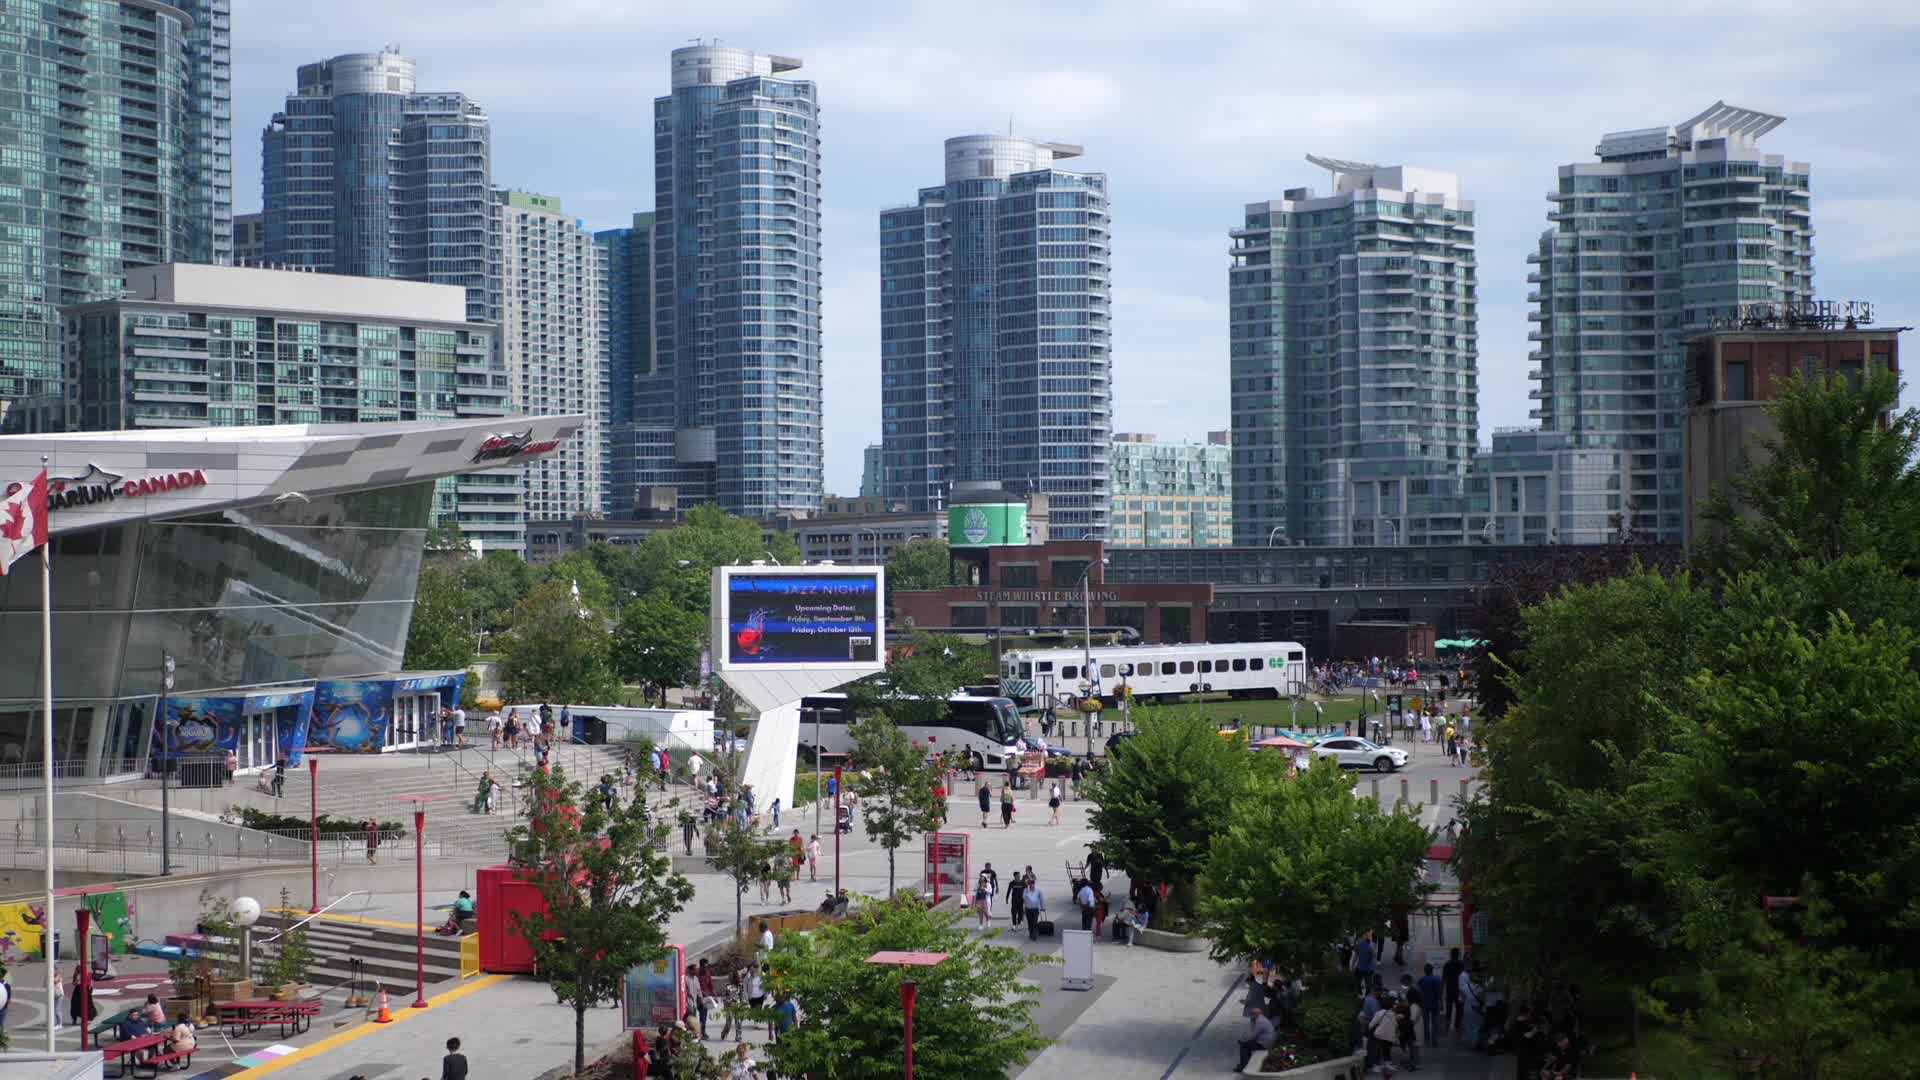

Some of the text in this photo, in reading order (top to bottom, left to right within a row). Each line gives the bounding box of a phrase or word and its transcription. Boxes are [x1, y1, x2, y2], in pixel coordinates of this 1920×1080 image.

[123, 470, 207, 497] CANADA
[784, 583, 869, 595] JAZZ NIGHT
[976, 591, 1010, 601] STEAM
[1013, 591, 1061, 601] WHISTLE
[795, 604, 832, 613] Upcoming
[813, 616, 853, 624] September
[791, 626, 816, 634] Friday,
